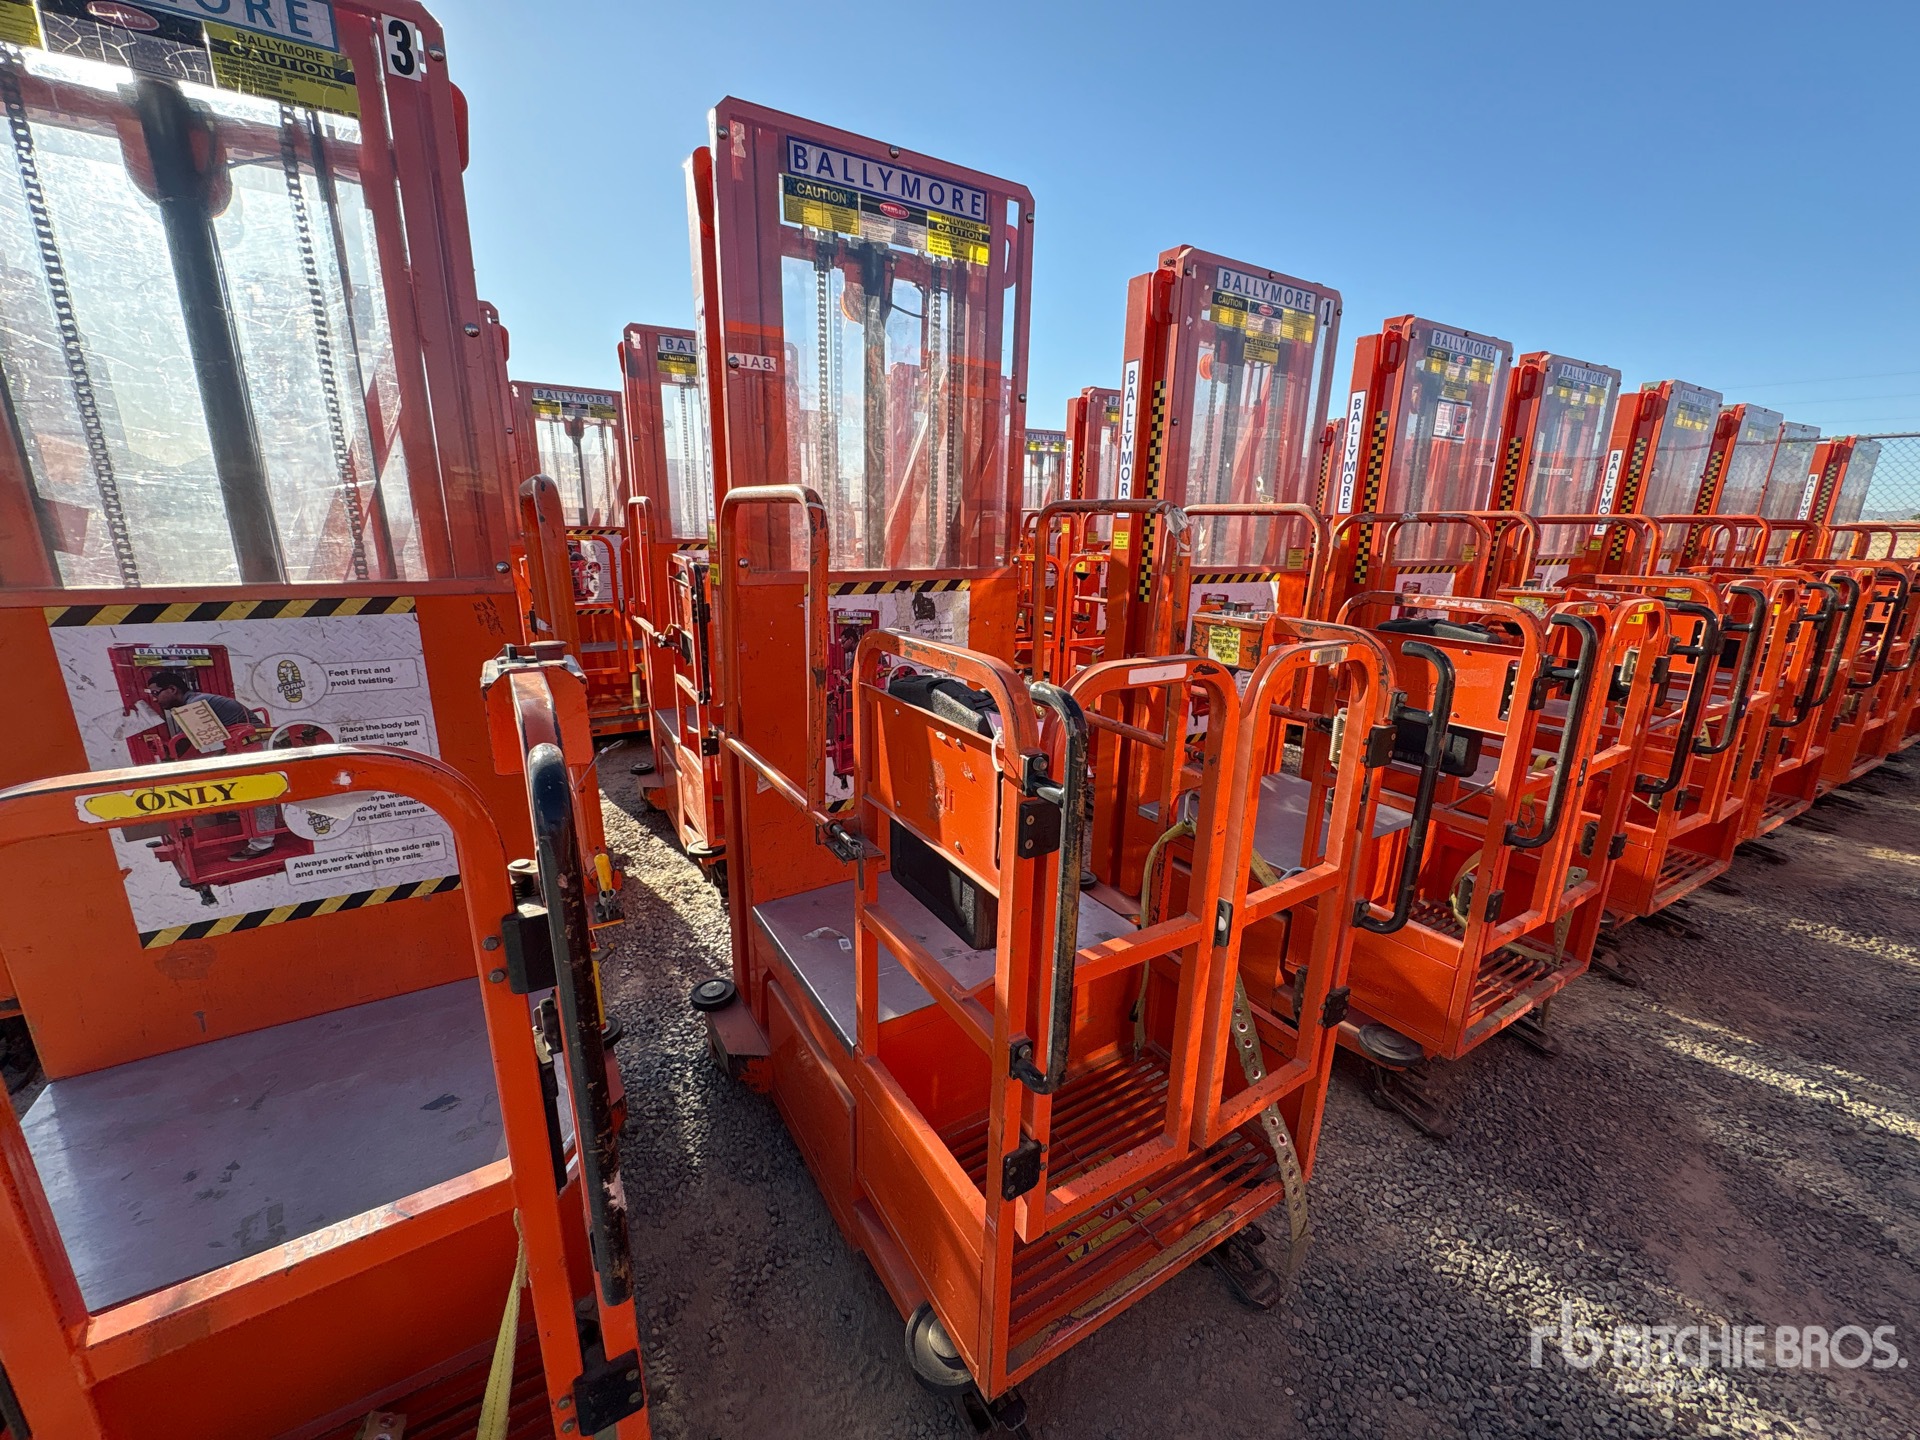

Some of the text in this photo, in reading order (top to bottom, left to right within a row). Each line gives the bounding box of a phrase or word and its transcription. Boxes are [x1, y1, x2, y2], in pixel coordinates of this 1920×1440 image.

[236, 31, 325, 62] BALLYMORE
[387, 20, 416, 76] 3
[229, 45, 336, 79] CAUTION
[793, 144, 981, 216] BALLYMORE
[796, 182, 847, 205] CAUTION
[936, 223, 983, 241] CAUTION
[941, 215, 979, 231] BALLYMORE
[1217, 295, 1243, 309] CAUTION
[1222, 271, 1312, 310] BALLYMORE
[1323, 301, 1331, 326] 1
[1435, 333, 1493, 358] BALLYMORE
[1563, 365, 1606, 386] BALLYMORE
[537, 389, 609, 404] BALLYMORE
[1121, 370, 1136, 500] BALLYMOR
[1341, 398, 1361, 509] BALLYMORE
[1597, 453, 1618, 532] BALLYMOE
[328, 669, 349, 677] Feet
[351, 668, 372, 676] First
[330, 676, 396, 687] avoid twisting.
[277, 680, 306, 694] FORM
[286, 688, 300, 697] UP
[340, 719, 420, 734] Place the body belt
[341, 729, 418, 743] and static lanyard
[135, 782, 238, 811] ONLY
[380, 802, 396, 810] belt
[369, 812, 392, 820] static
[394, 806, 428, 818] lanyard.
[293, 858, 329, 870] Always
[330, 854, 353, 864] work
[355, 849, 383, 858] within
[401, 843, 420, 851] side
[422, 840, 441, 848] rails
[295, 870, 314, 878] and
[316, 866, 342, 874] never
[344, 861, 370, 870] stand
[386, 855, 401, 864] the
[402, 852, 424, 861] rails.
